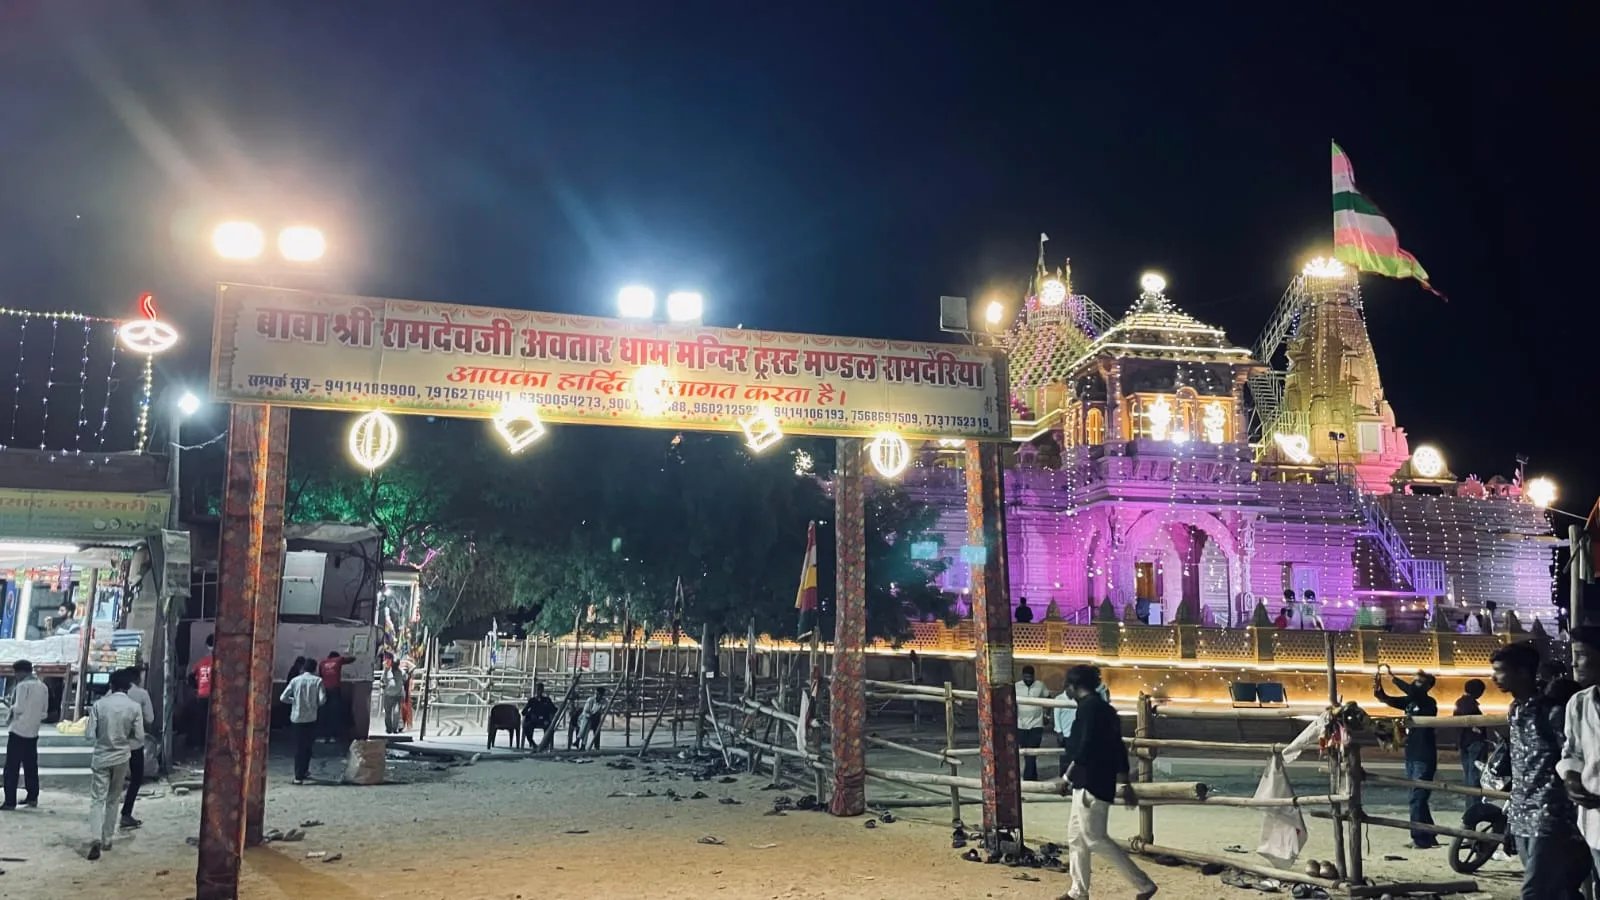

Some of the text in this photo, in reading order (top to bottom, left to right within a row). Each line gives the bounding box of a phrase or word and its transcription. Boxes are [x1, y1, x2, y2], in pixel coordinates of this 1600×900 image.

[256, 308, 328, 343] बाबा
[332, 305, 375, 346] श्री
[383, 313, 514, 356] रामदेवजी
[520, 329, 613, 363] अवतार
[619, 337, 671, 366] धाम
[676, 335, 749, 372] मन्दिर
[753, 347, 799, 379] ट्रस्ट
[803, 351, 877, 380] मण्डल
[248, 373, 287, 388] सम्पर्क
[447, 366, 552, 388] आपका
[744, 385, 812, 403] करता
